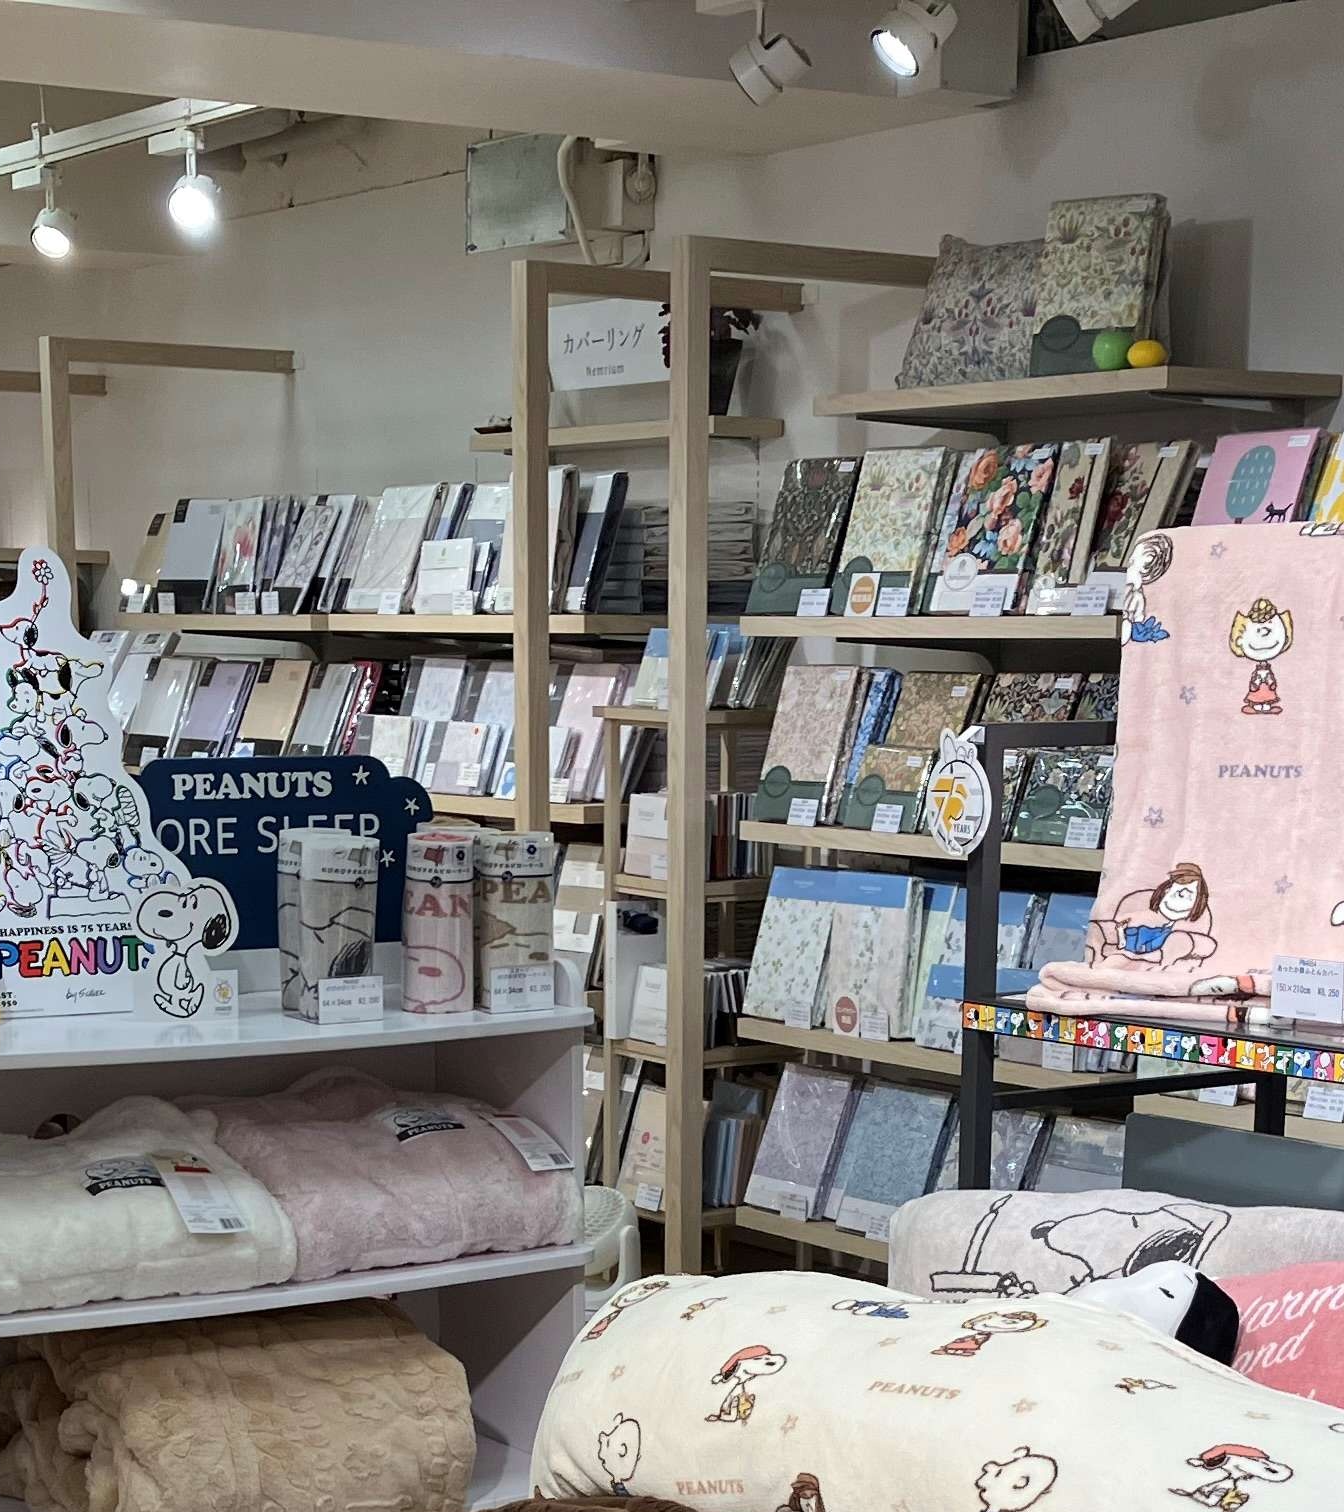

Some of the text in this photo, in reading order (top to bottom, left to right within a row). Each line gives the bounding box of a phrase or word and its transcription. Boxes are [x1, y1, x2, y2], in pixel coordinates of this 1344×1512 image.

[563, 323, 645, 354] カバーリング
[1217, 764, 1303, 779] PEANUTS
[171, 771, 332, 800] PEANUTS
[156, 817, 239, 855] ORE
[0, 926, 65, 937] HAPPINESS
[67, 924, 79, 935] IS
[81, 924, 94, 935] 75
[408, 1122, 455, 1137] PEANUTS
[98, 1177, 152, 1190] PEANUTS
[867, 1380, 961, 1400] PEANUTS
[675, 1478, 745, 1496] PEANUTS
